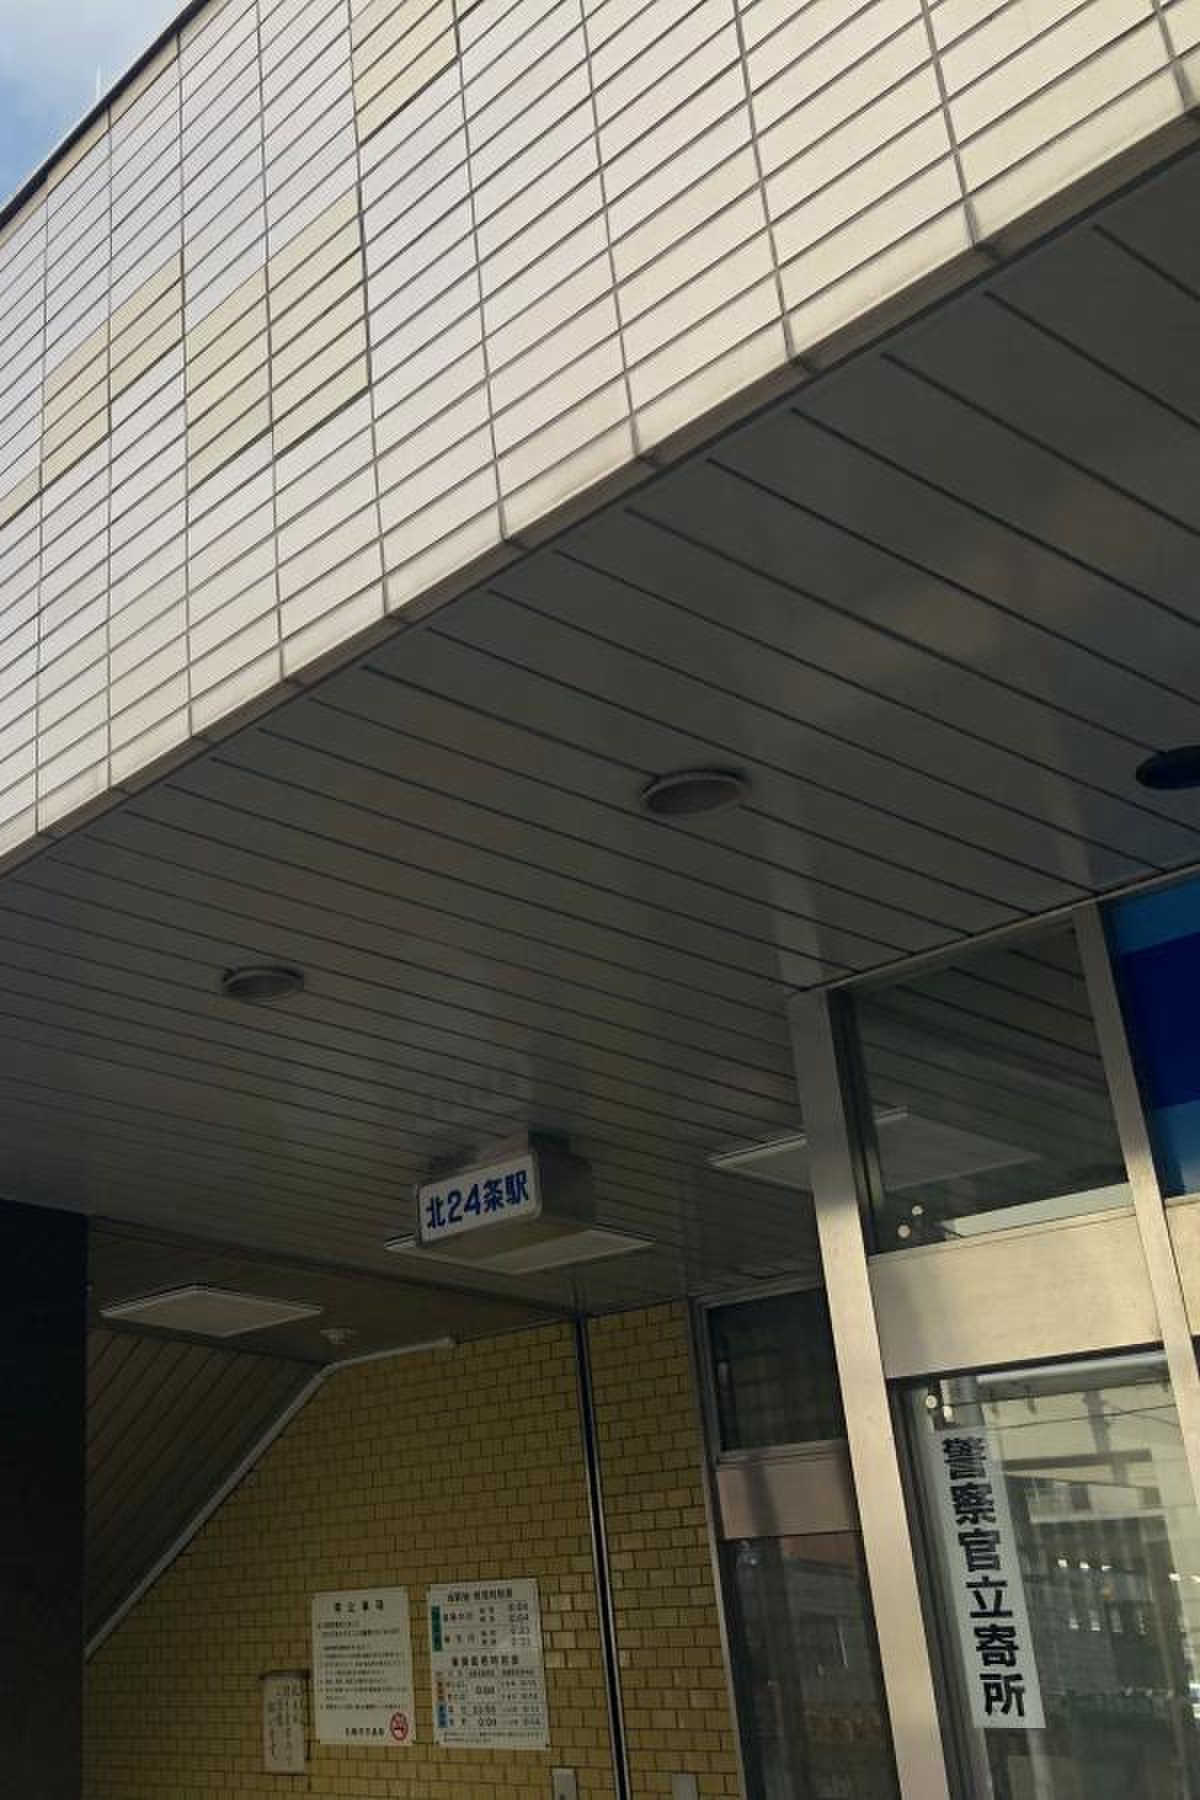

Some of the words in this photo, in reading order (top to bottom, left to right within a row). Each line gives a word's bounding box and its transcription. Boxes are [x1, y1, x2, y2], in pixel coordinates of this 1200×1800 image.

[425, 1170, 529, 1229] 北24条駅
[942, 1436, 1026, 1718] 警察官立寄所
